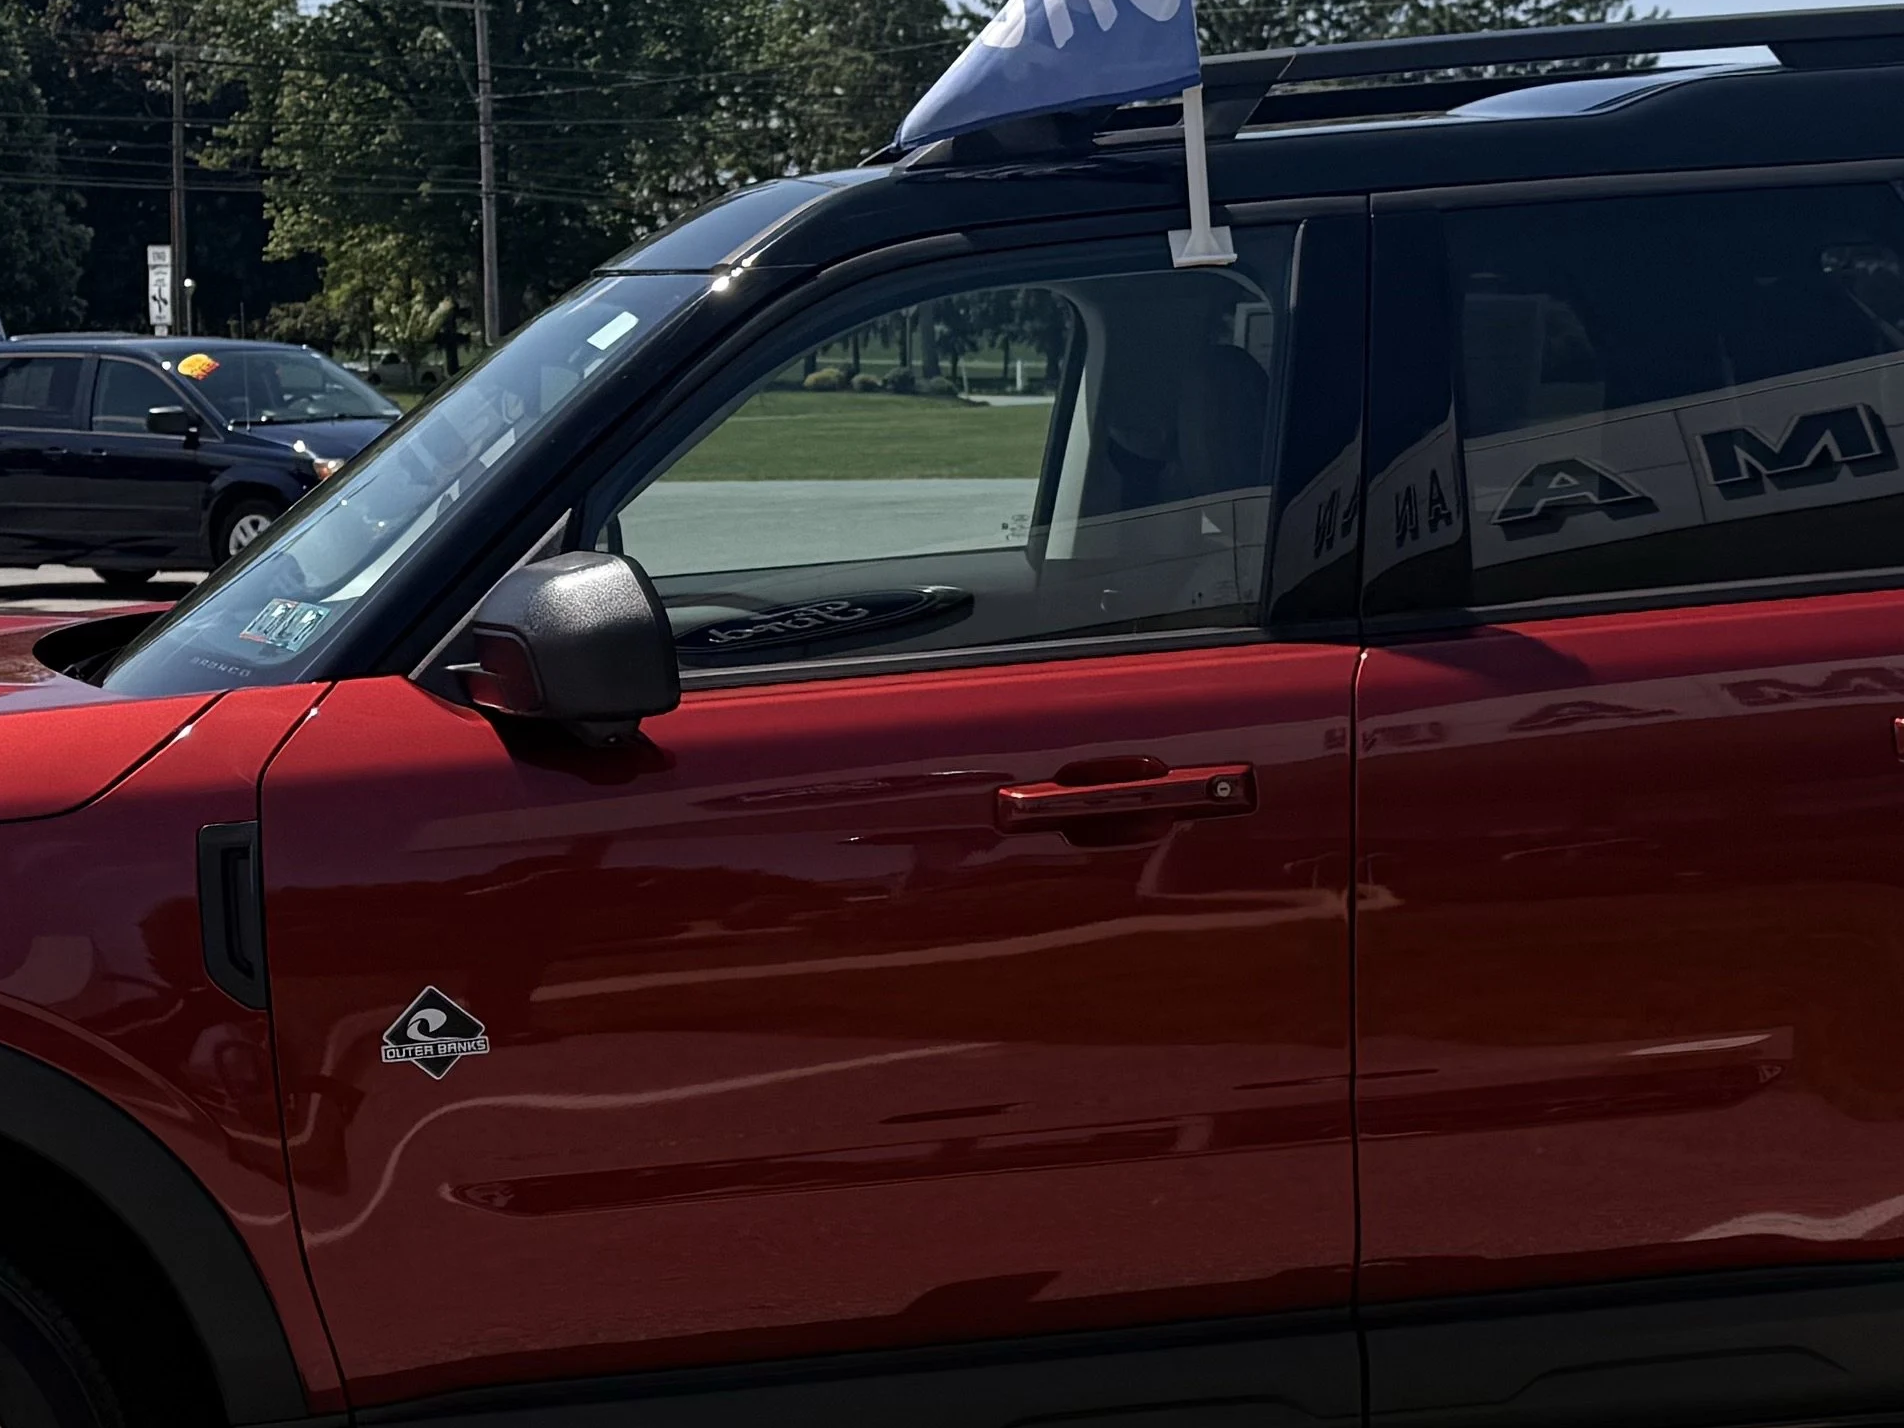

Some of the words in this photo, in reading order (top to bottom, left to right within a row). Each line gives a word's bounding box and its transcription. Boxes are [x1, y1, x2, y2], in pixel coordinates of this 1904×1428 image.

[190, 656, 251, 677] BRONCO
[386, 1045, 434, 1059] OUTER
[438, 1040, 487, 1055] BANKS
